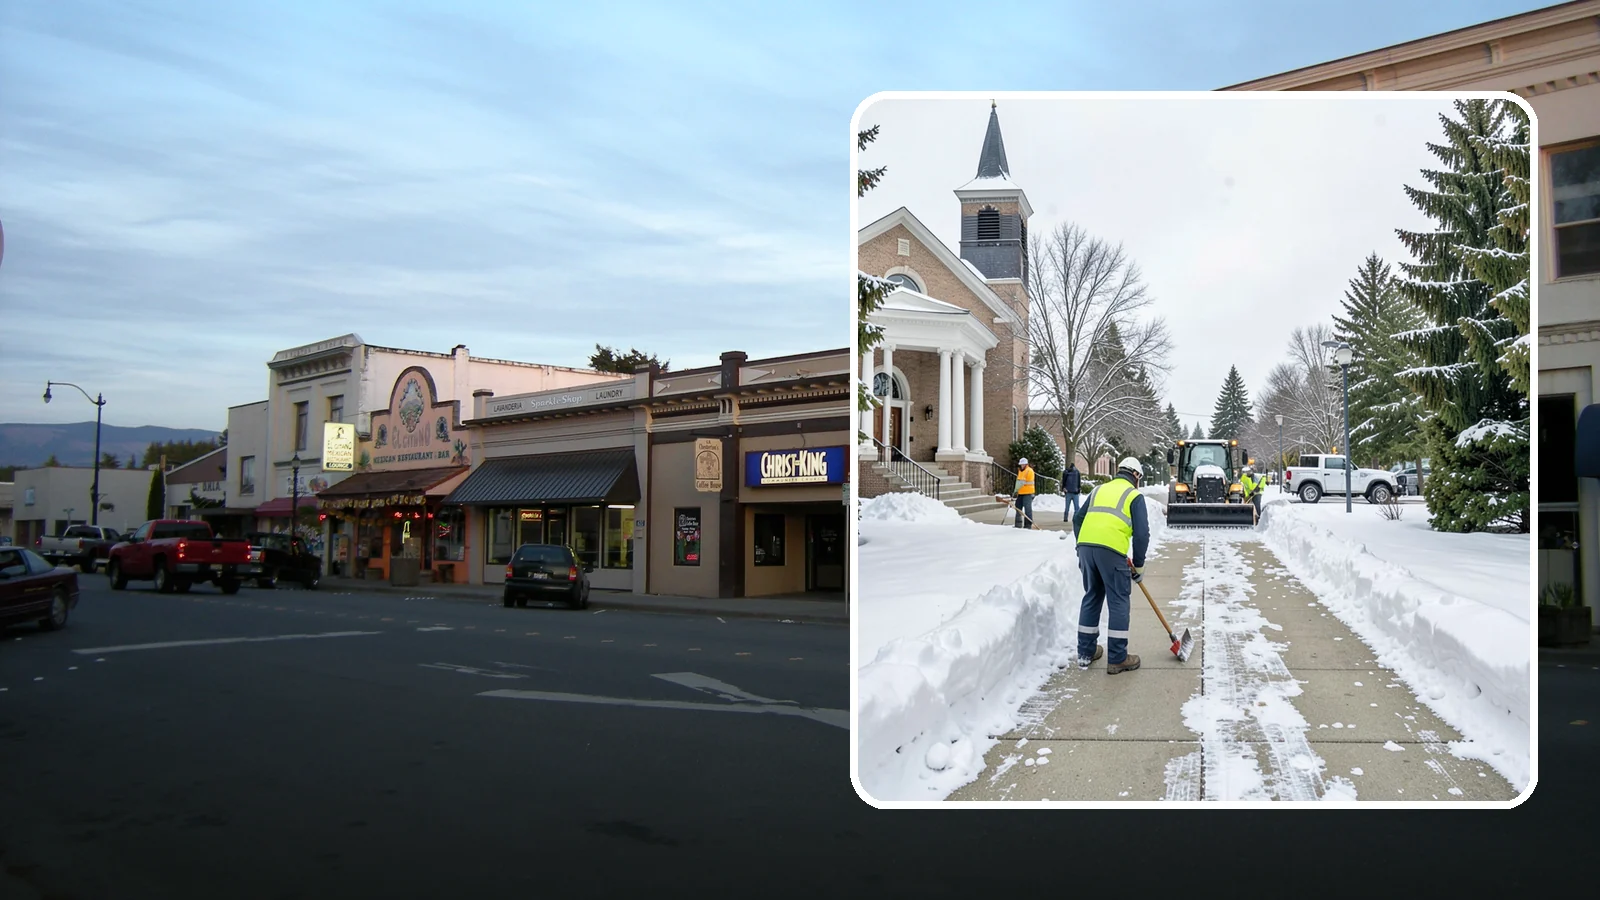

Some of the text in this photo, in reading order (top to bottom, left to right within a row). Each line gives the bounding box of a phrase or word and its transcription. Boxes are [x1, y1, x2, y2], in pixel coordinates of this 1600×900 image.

[493, 389, 624, 413] LAVANDERIA Sparkle Shop LAUNDRY
[392, 426, 401, 449] EL
[373, 455, 396, 464] MEXICAN
[397, 451, 434, 462] RESTAURANT
[437, 450, 450, 459] BAR
[760, 451, 797, 478] CHRIST
[799, 449, 827, 476] KING
